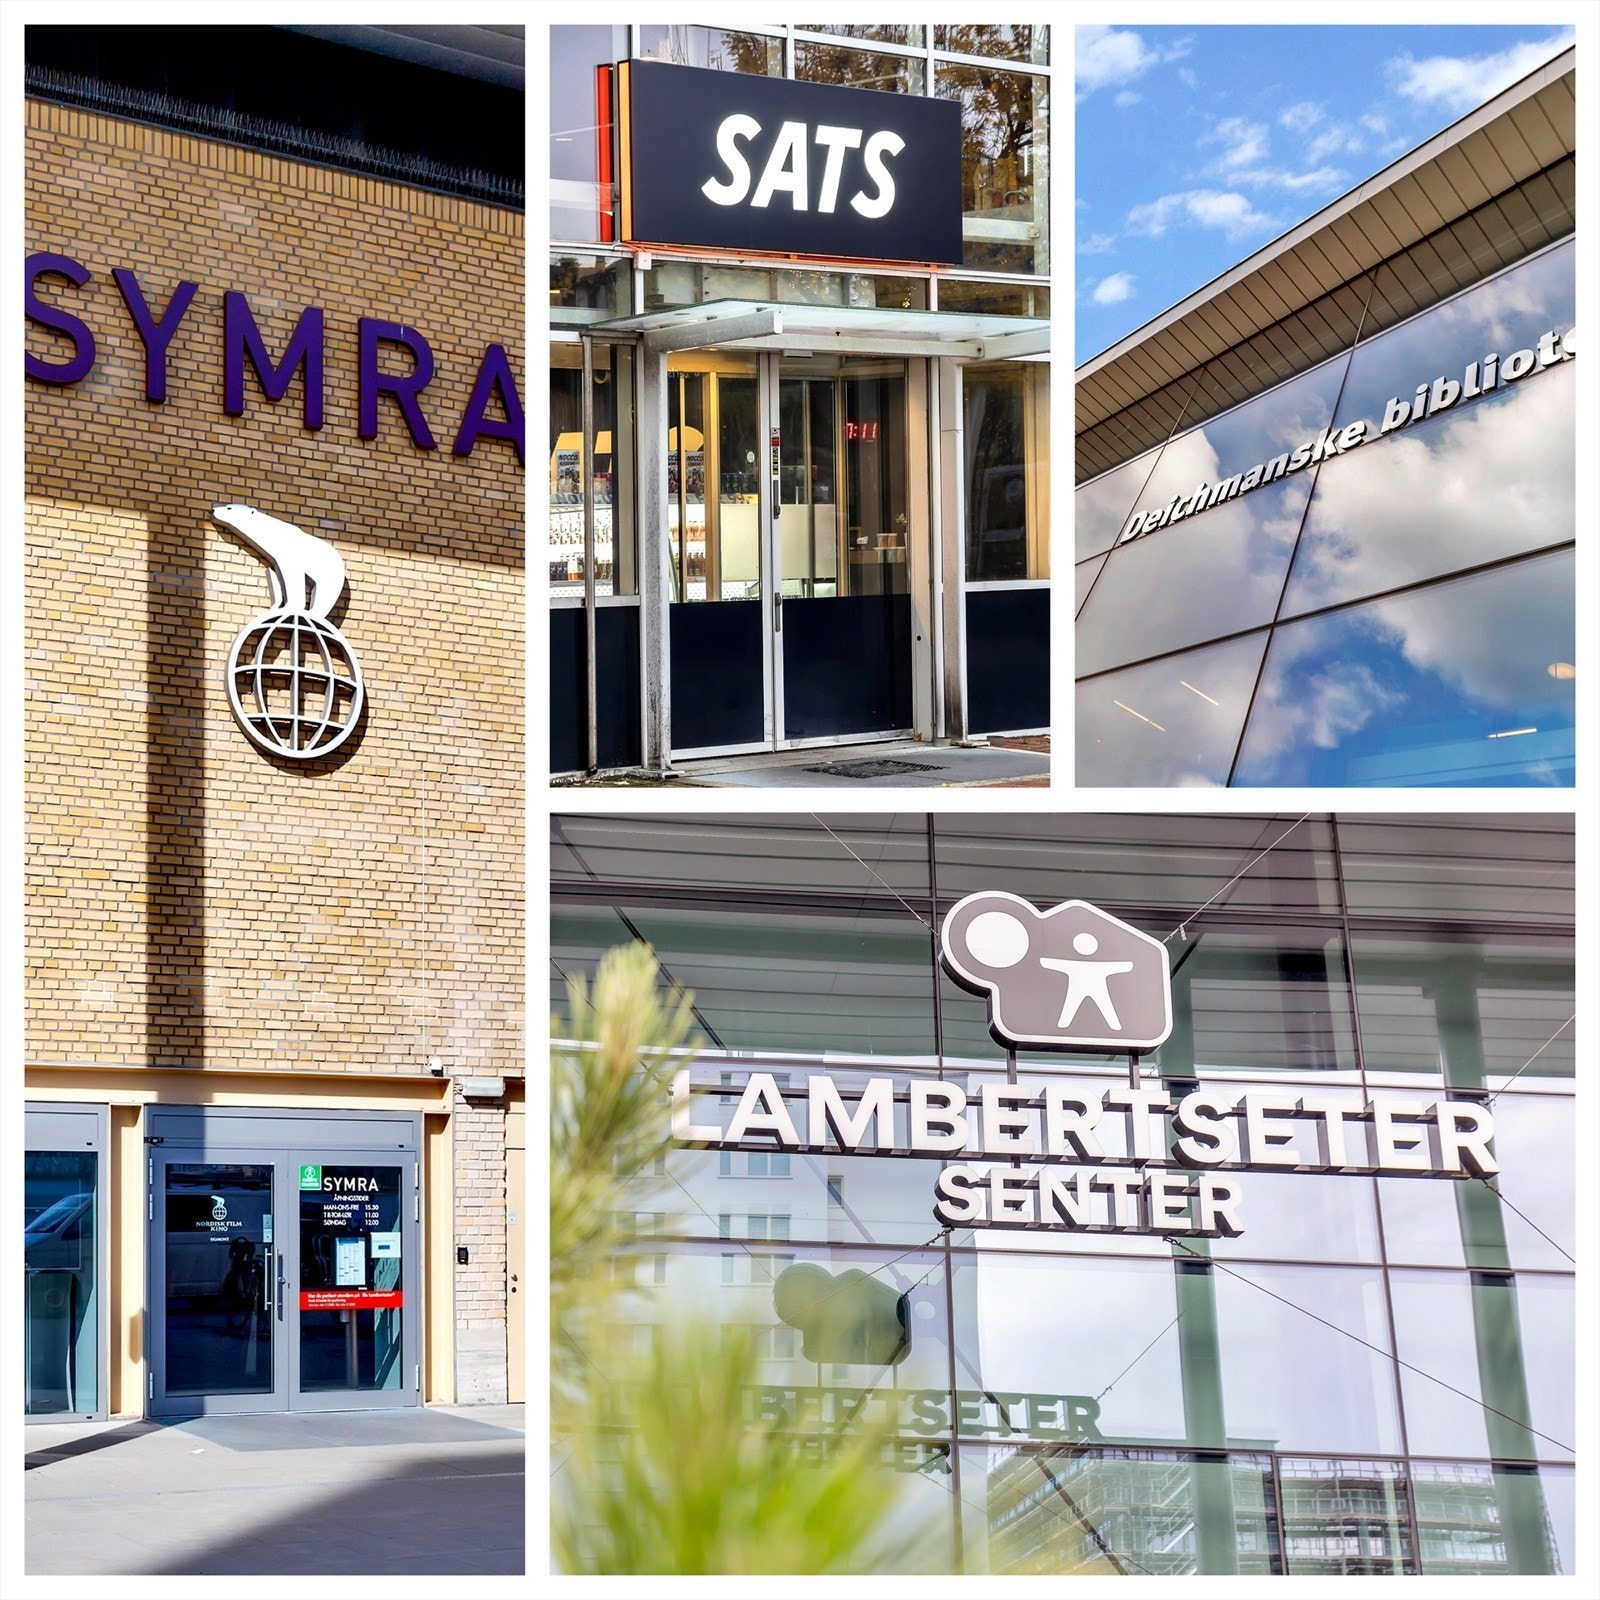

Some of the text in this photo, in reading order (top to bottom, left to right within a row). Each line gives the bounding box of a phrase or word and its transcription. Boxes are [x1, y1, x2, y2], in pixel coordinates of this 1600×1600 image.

[701, 113, 906, 218] SATS
[24, 251, 525, 468] SYMRA
[846, 422, 877, 439] 7:11
[1119, 419, 1367, 544] Deichmanske
[671, 1069, 1500, 1178] LAMBERTSETER
[323, 1177, 379, 1192] SYMRA
[935, 1164, 1245, 1237] SENTER
